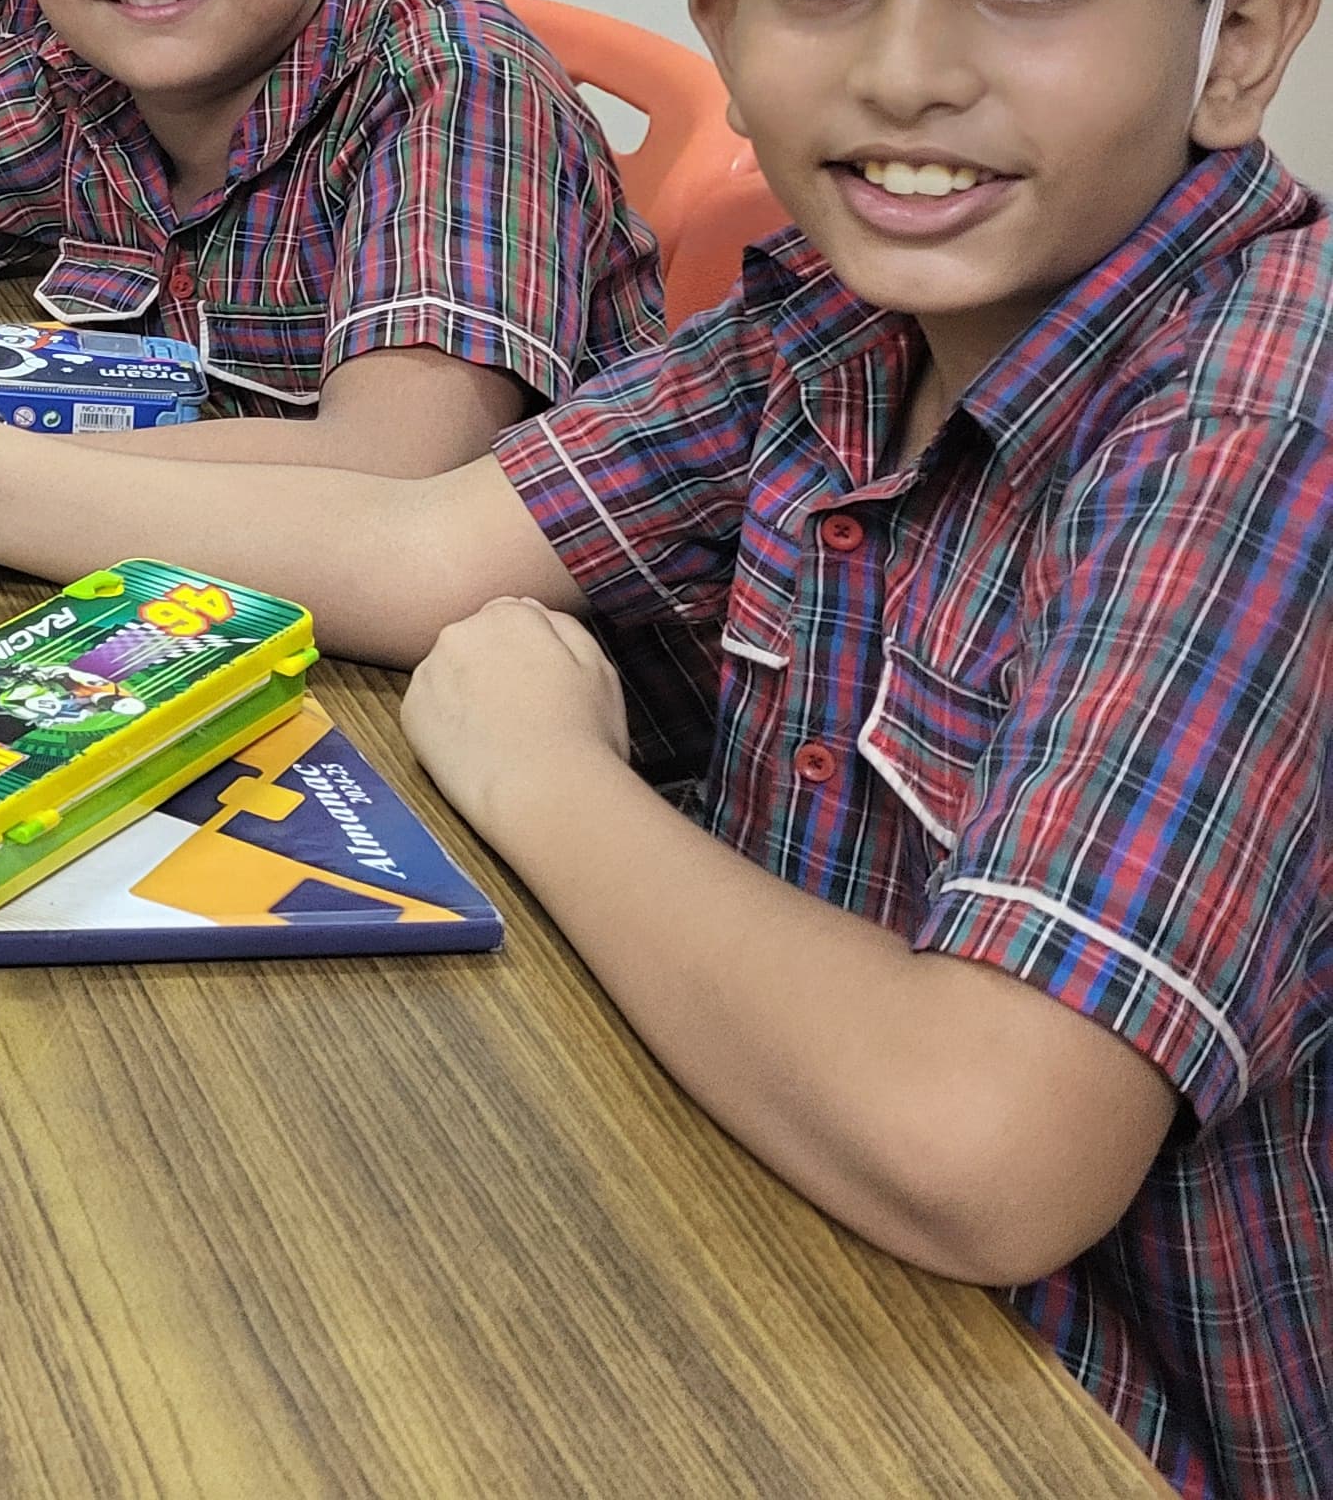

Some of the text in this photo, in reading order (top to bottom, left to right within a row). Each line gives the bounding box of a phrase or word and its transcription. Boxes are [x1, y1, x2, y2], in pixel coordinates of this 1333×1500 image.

[99, 368, 192, 383] Dream
[116, 363, 172, 373] space
[138, 583, 237, 638] 46
[292, 764, 408, 881] Almanac
